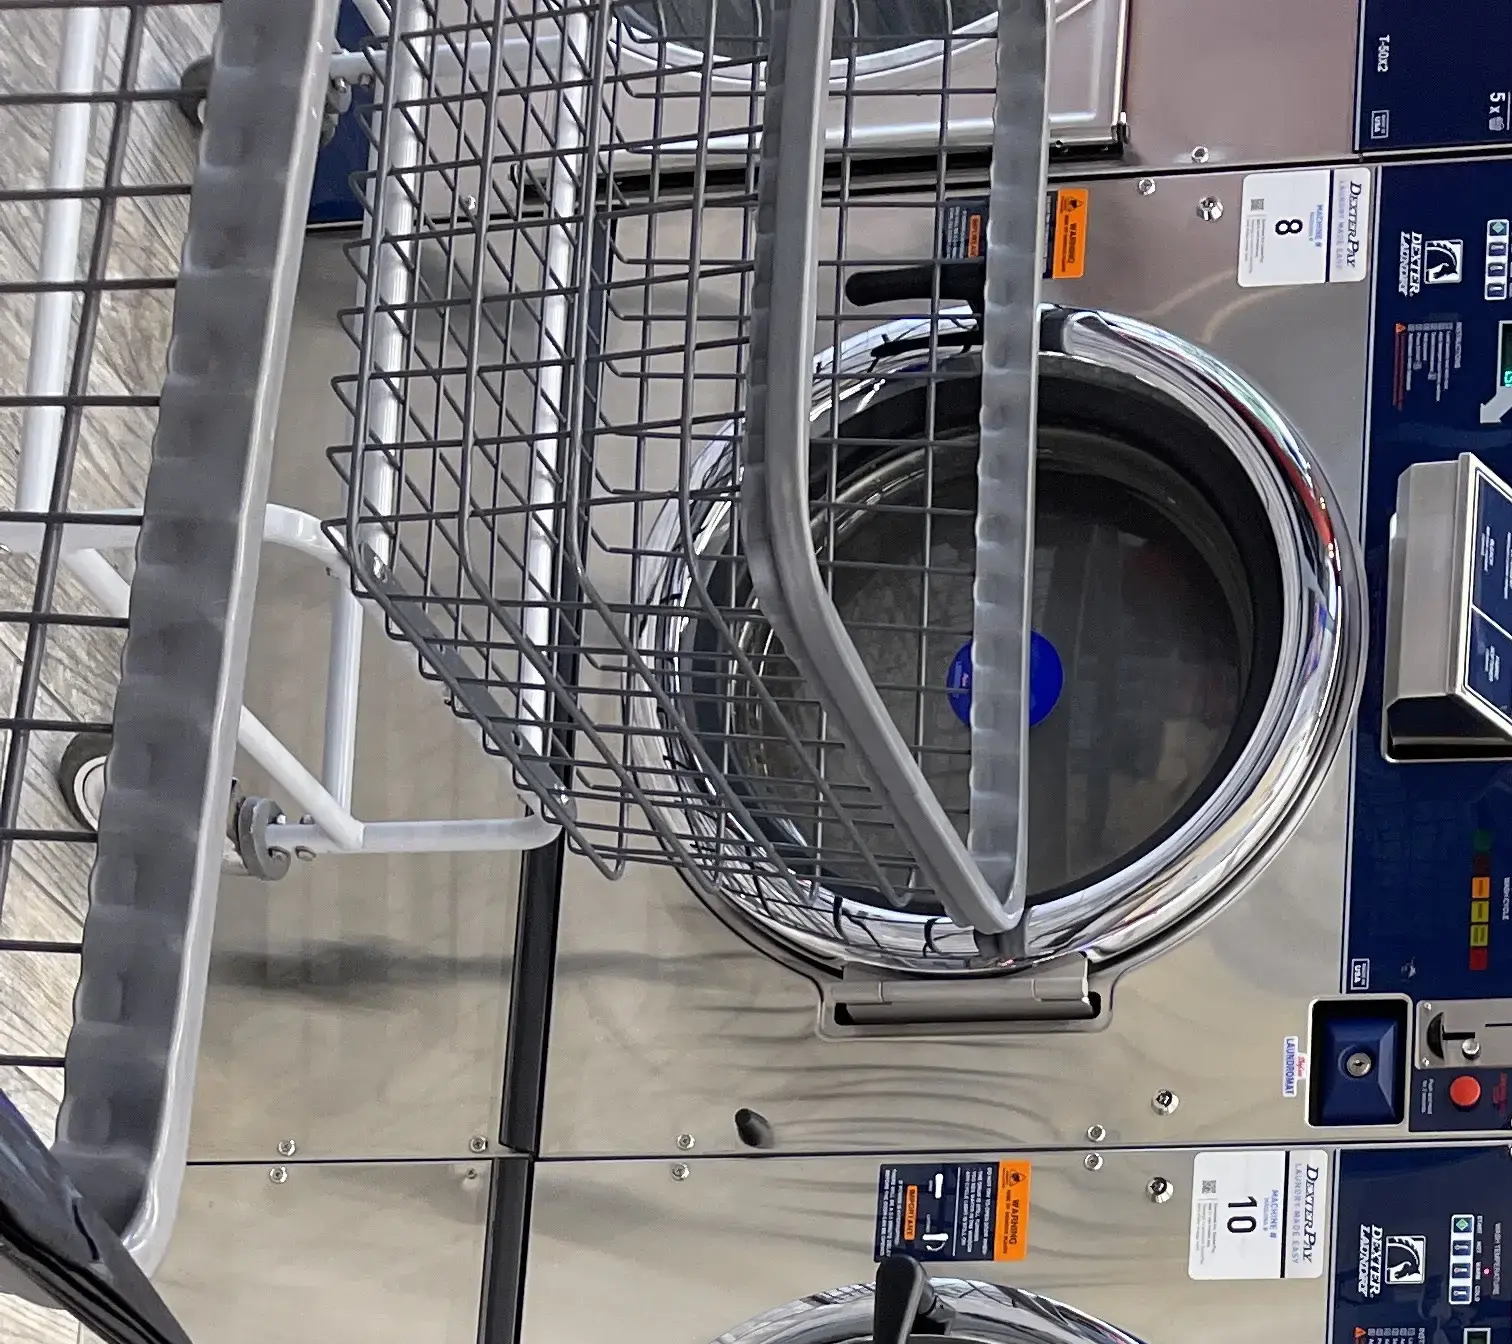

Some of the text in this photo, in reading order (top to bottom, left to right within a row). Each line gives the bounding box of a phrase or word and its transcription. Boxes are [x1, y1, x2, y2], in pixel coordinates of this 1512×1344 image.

[1489, 92, 1505, 114] 5 x
[1275, 219, 1303, 235] 8
[1410, 232, 1422, 294] DEXTER
[1353, 965, 1362, 983] USA
[1284, 1038, 1296, 1095] LAUNDROMAT
[906, 1189, 915, 1236] IMPORTANT
[1009, 1199, 1019, 1244] WARNING
[1227, 1196, 1257, 1234] 10
[1358, 1224, 1371, 1297] LAUNDRY
[1369, 1225, 1383, 1297] DEXTER
